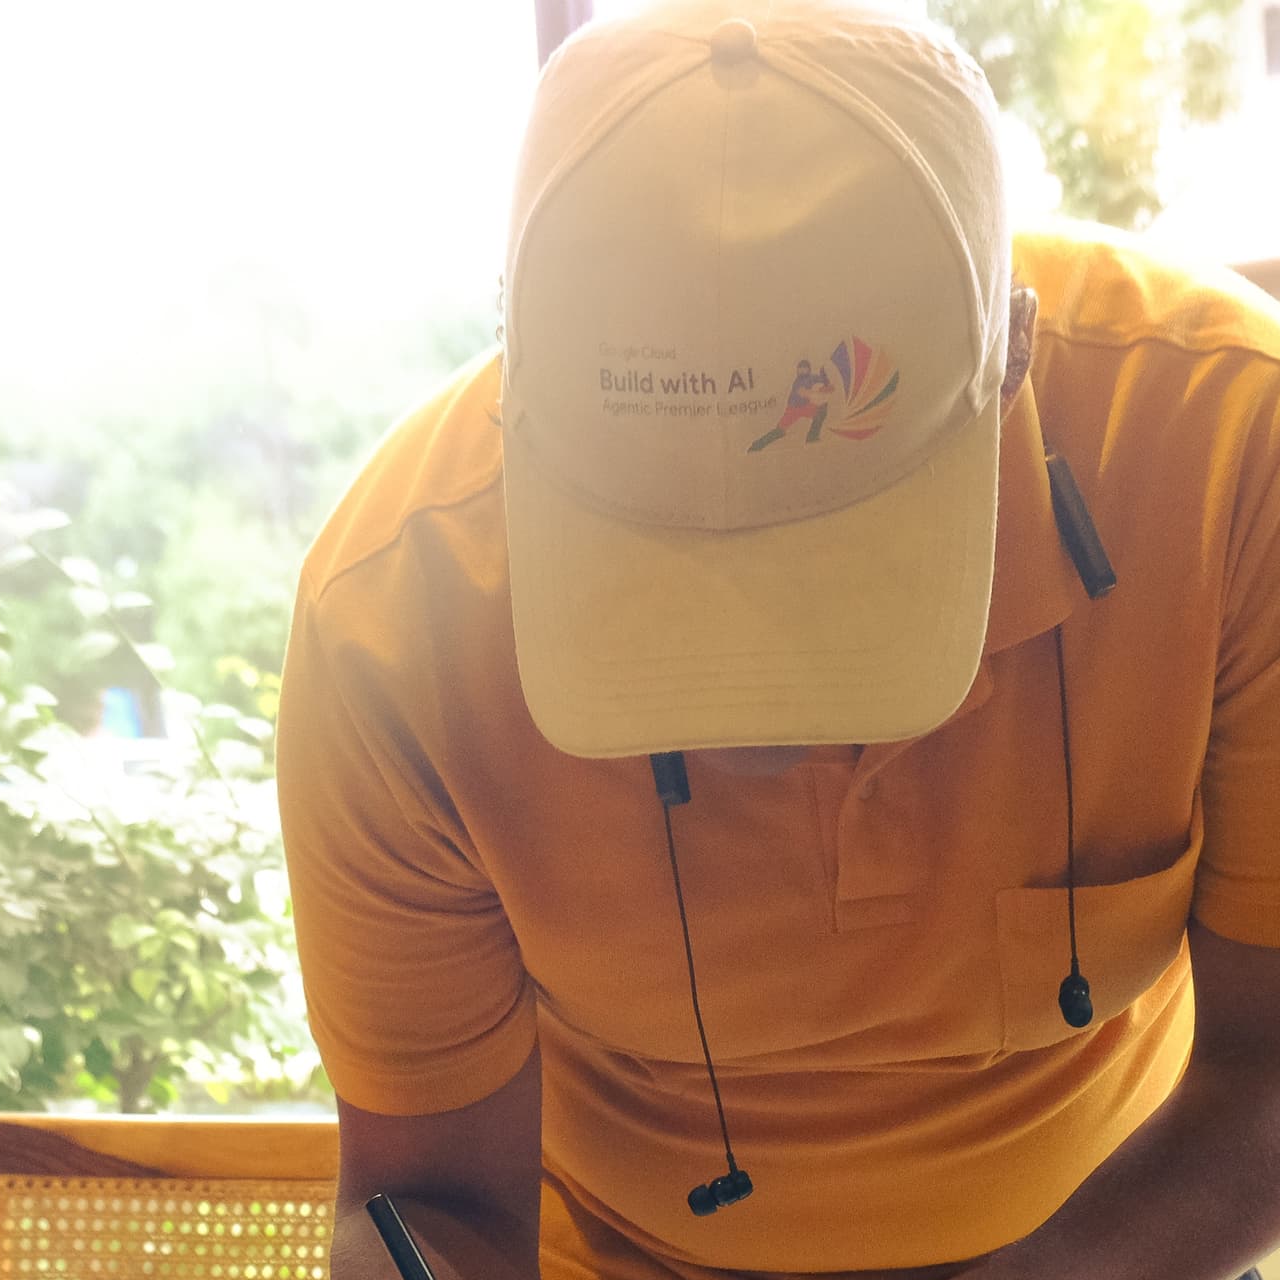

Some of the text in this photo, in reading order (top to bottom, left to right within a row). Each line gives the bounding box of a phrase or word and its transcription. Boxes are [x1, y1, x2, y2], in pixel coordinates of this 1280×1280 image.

[599, 367, 754, 395] Build with AI
[602, 399, 651, 417] Agentic
[655, 401, 711, 416] Premier
